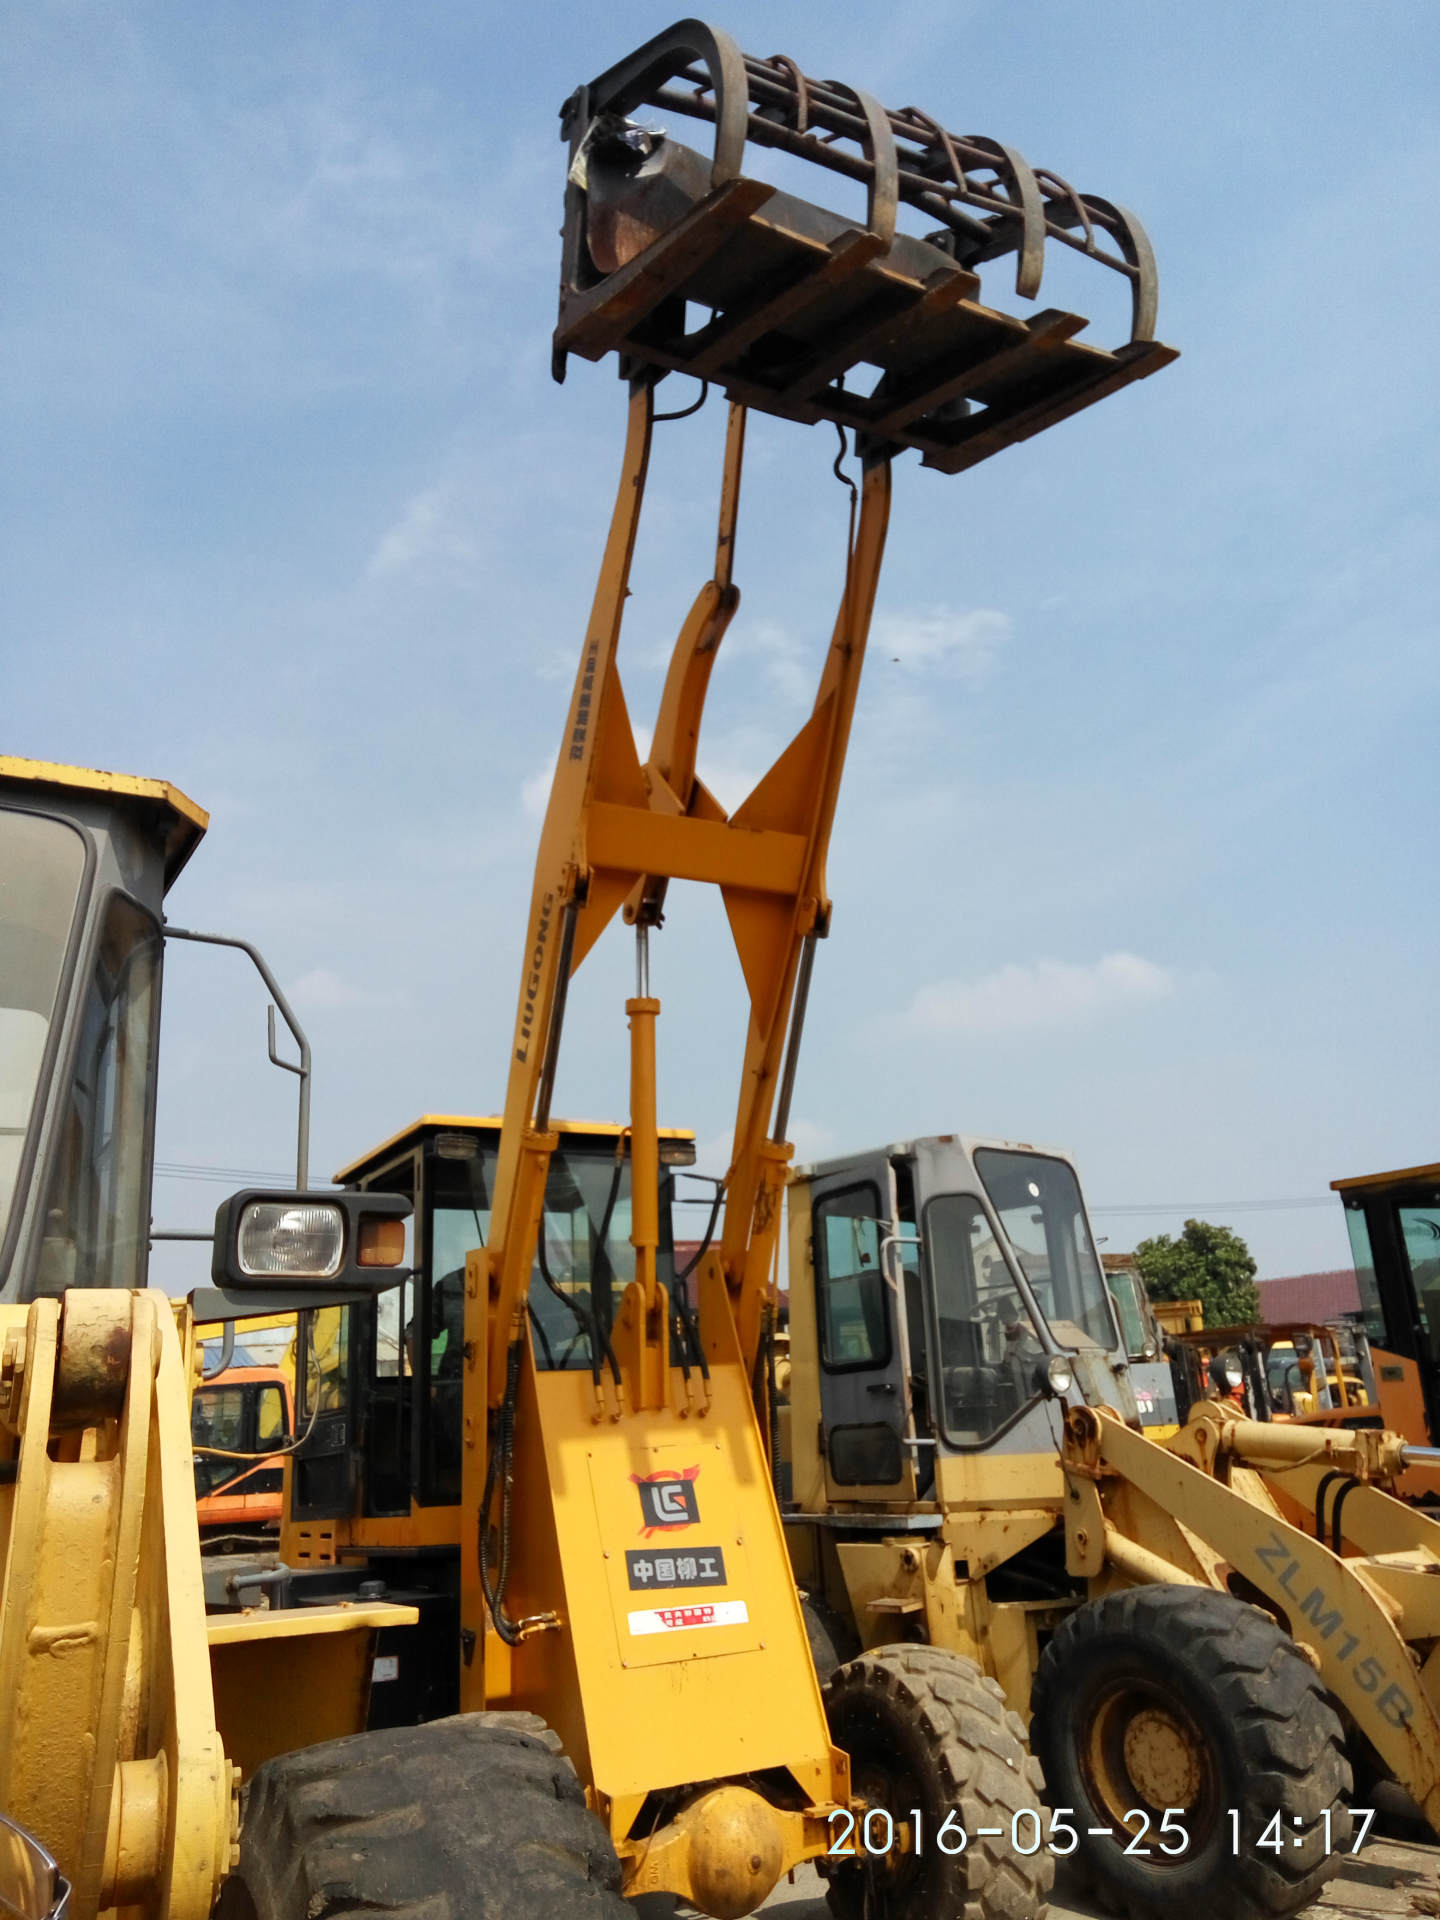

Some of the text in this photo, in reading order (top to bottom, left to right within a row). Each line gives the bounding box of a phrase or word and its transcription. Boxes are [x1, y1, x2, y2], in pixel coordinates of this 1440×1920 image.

[516, 892, 554, 1064] LIUGONG
[632, 1556, 720, 1583] 中国柳工
[1256, 1531, 1414, 1729] ZLM15B
